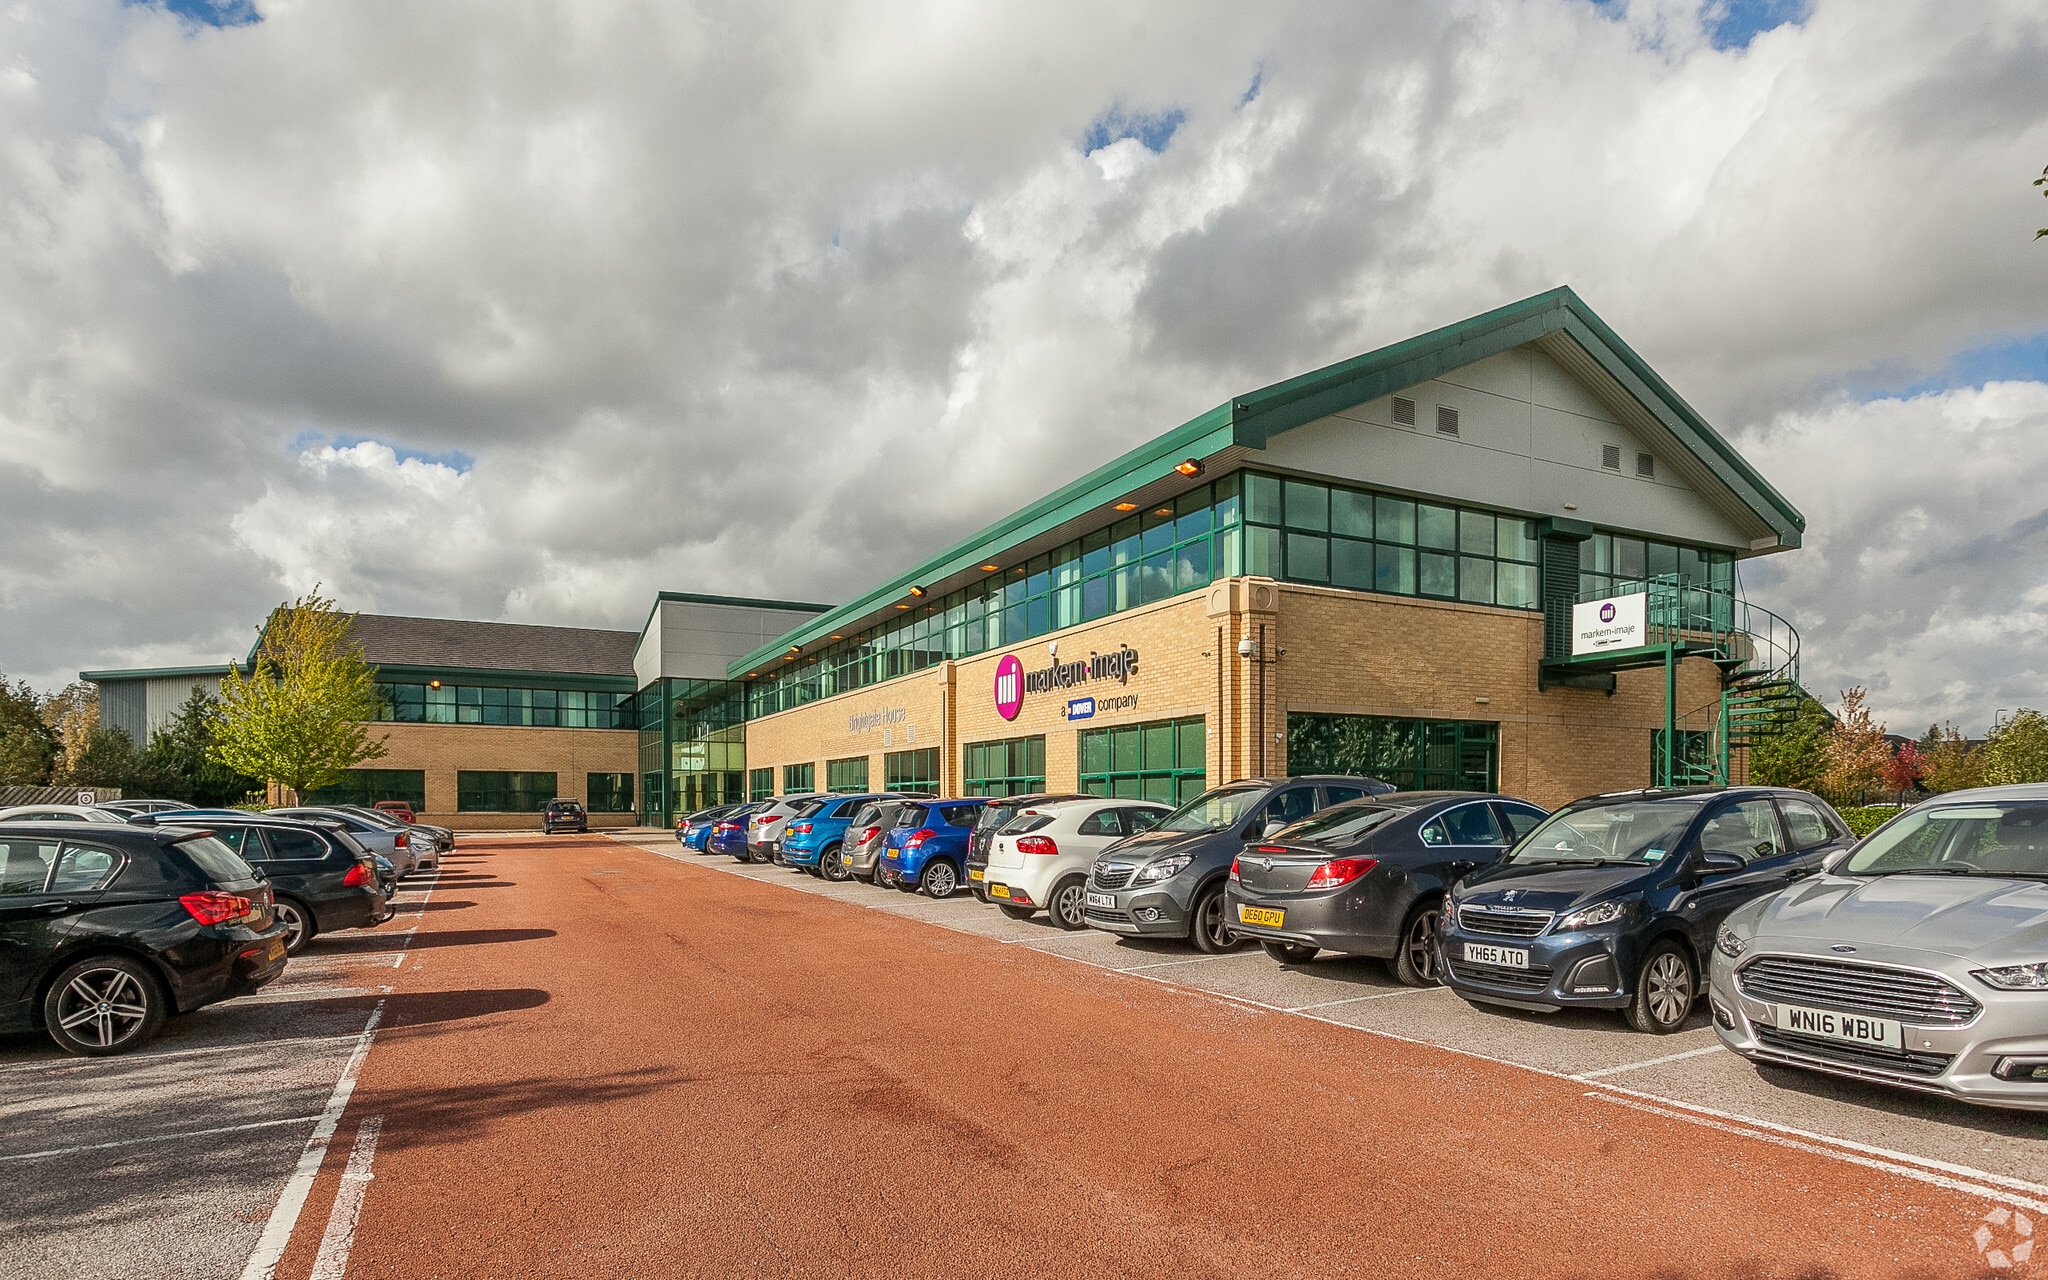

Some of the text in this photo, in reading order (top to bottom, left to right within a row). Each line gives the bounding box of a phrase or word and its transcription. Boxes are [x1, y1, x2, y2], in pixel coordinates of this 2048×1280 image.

[881, 706, 906, 725] House
[1060, 694, 1139, 717] a DOVER company
[1244, 908, 1281, 924] DE60 GPU
[1469, 945, 1523, 966] YH65 ATO
[1789, 1008, 1884, 1042] WN16 WBU
